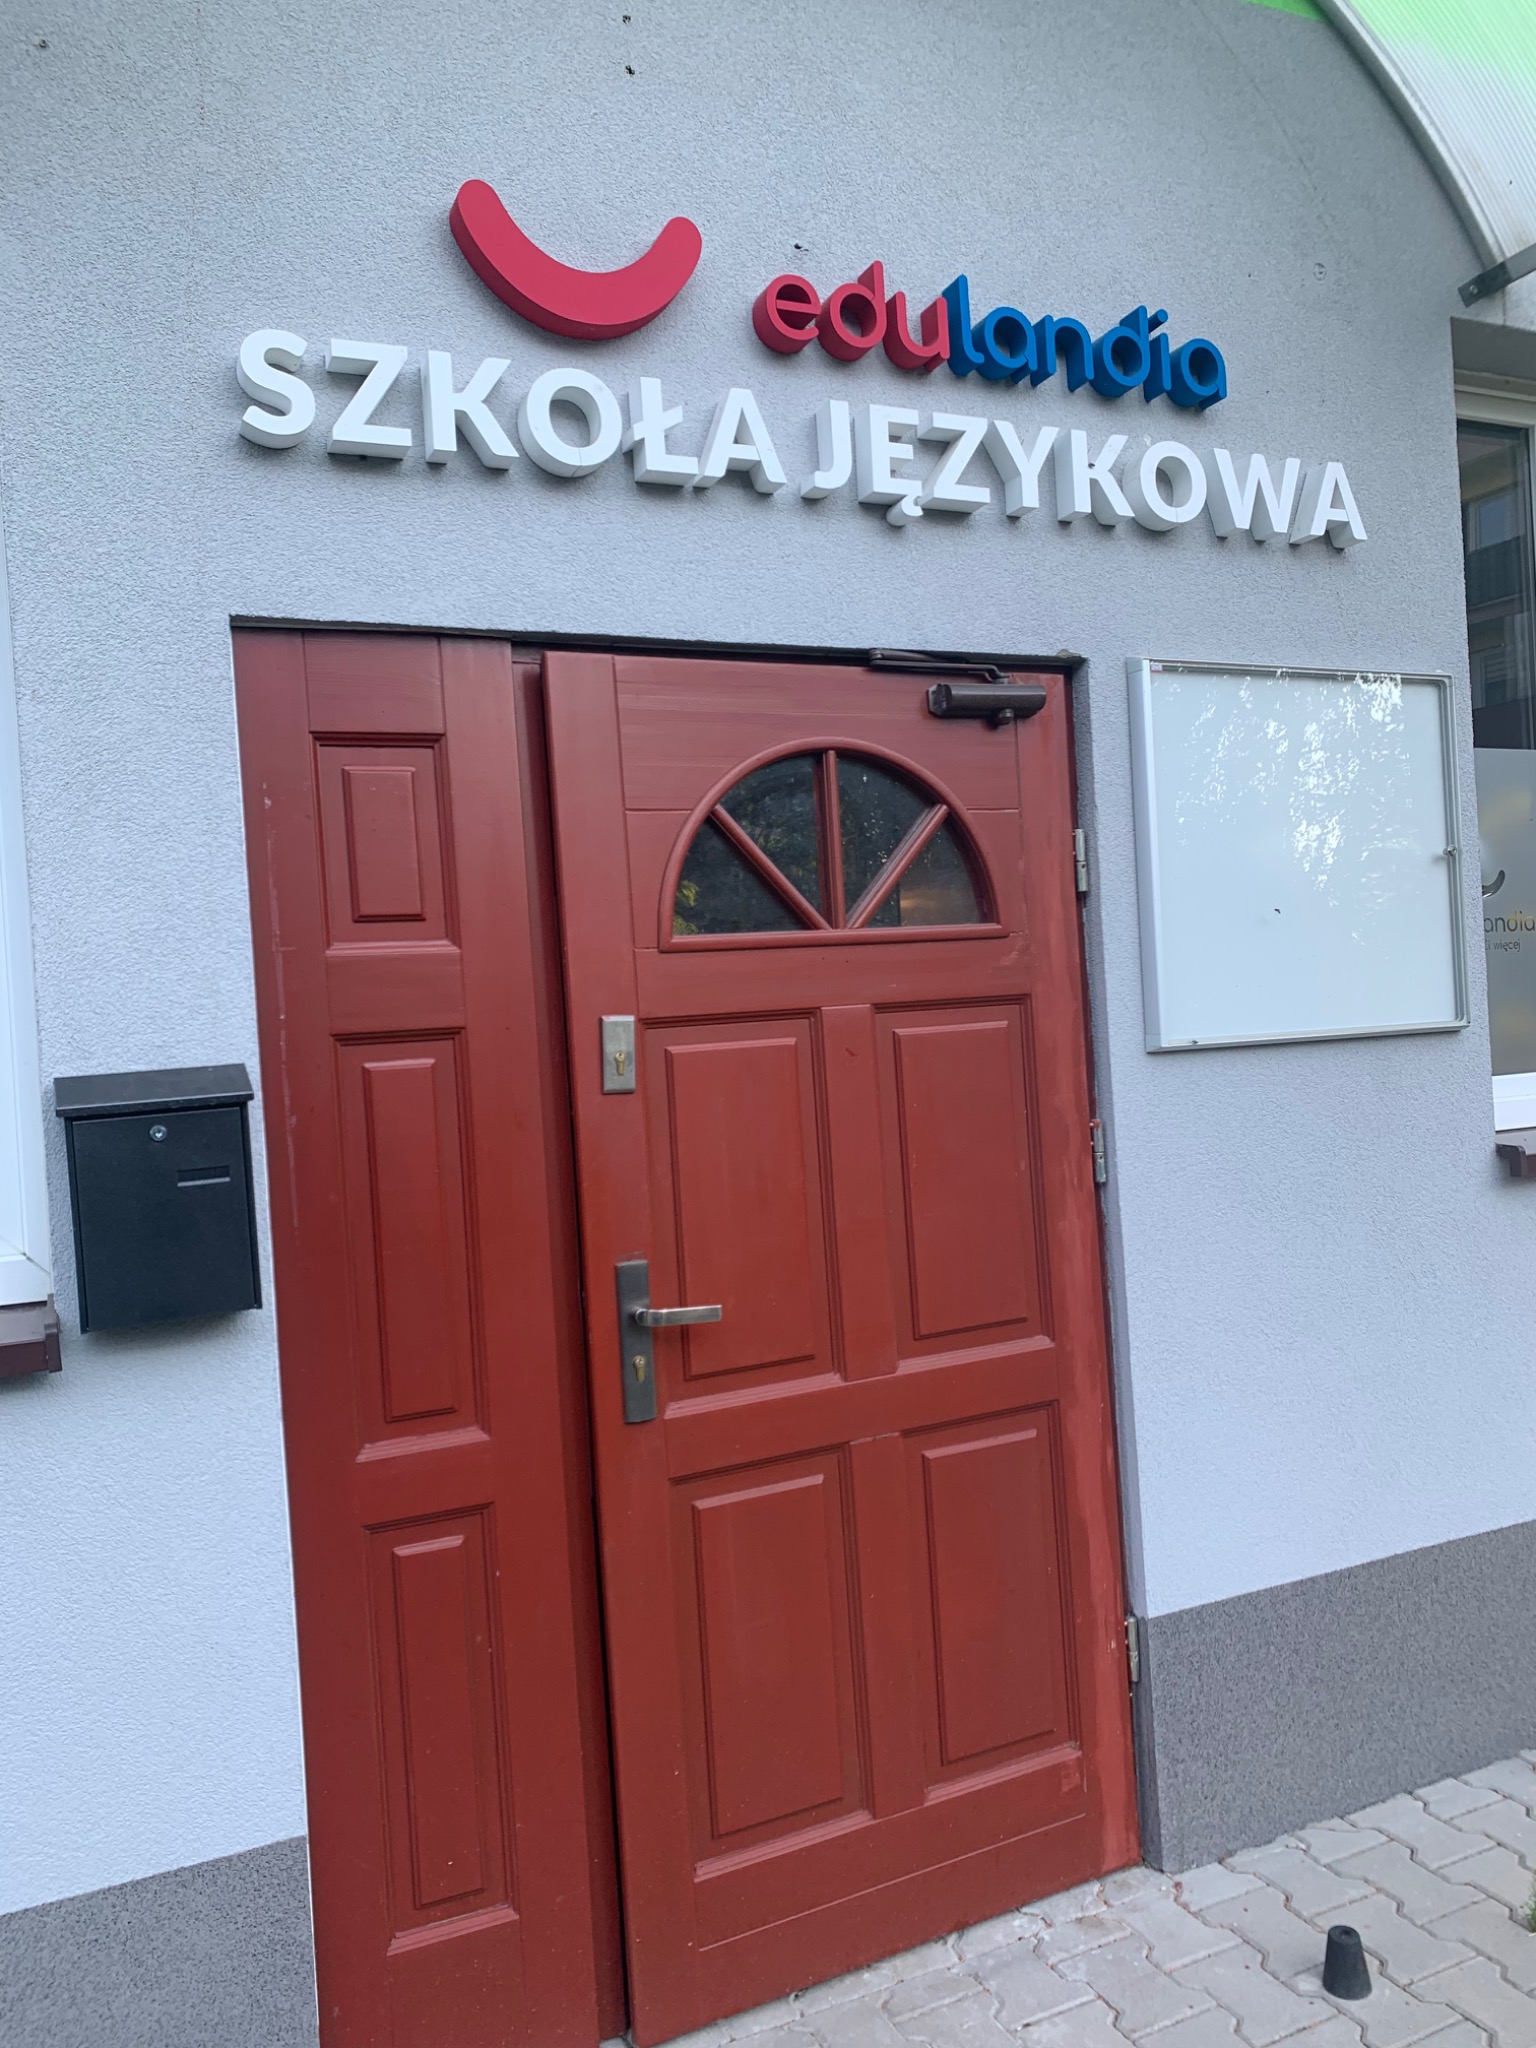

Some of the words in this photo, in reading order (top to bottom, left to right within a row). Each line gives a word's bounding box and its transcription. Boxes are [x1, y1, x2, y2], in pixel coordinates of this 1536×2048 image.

[753, 261, 1227, 410] edulandia
[237, 328, 787, 494] SZKOŁA
[801, 399, 1368, 549] JĘZYKOWA
